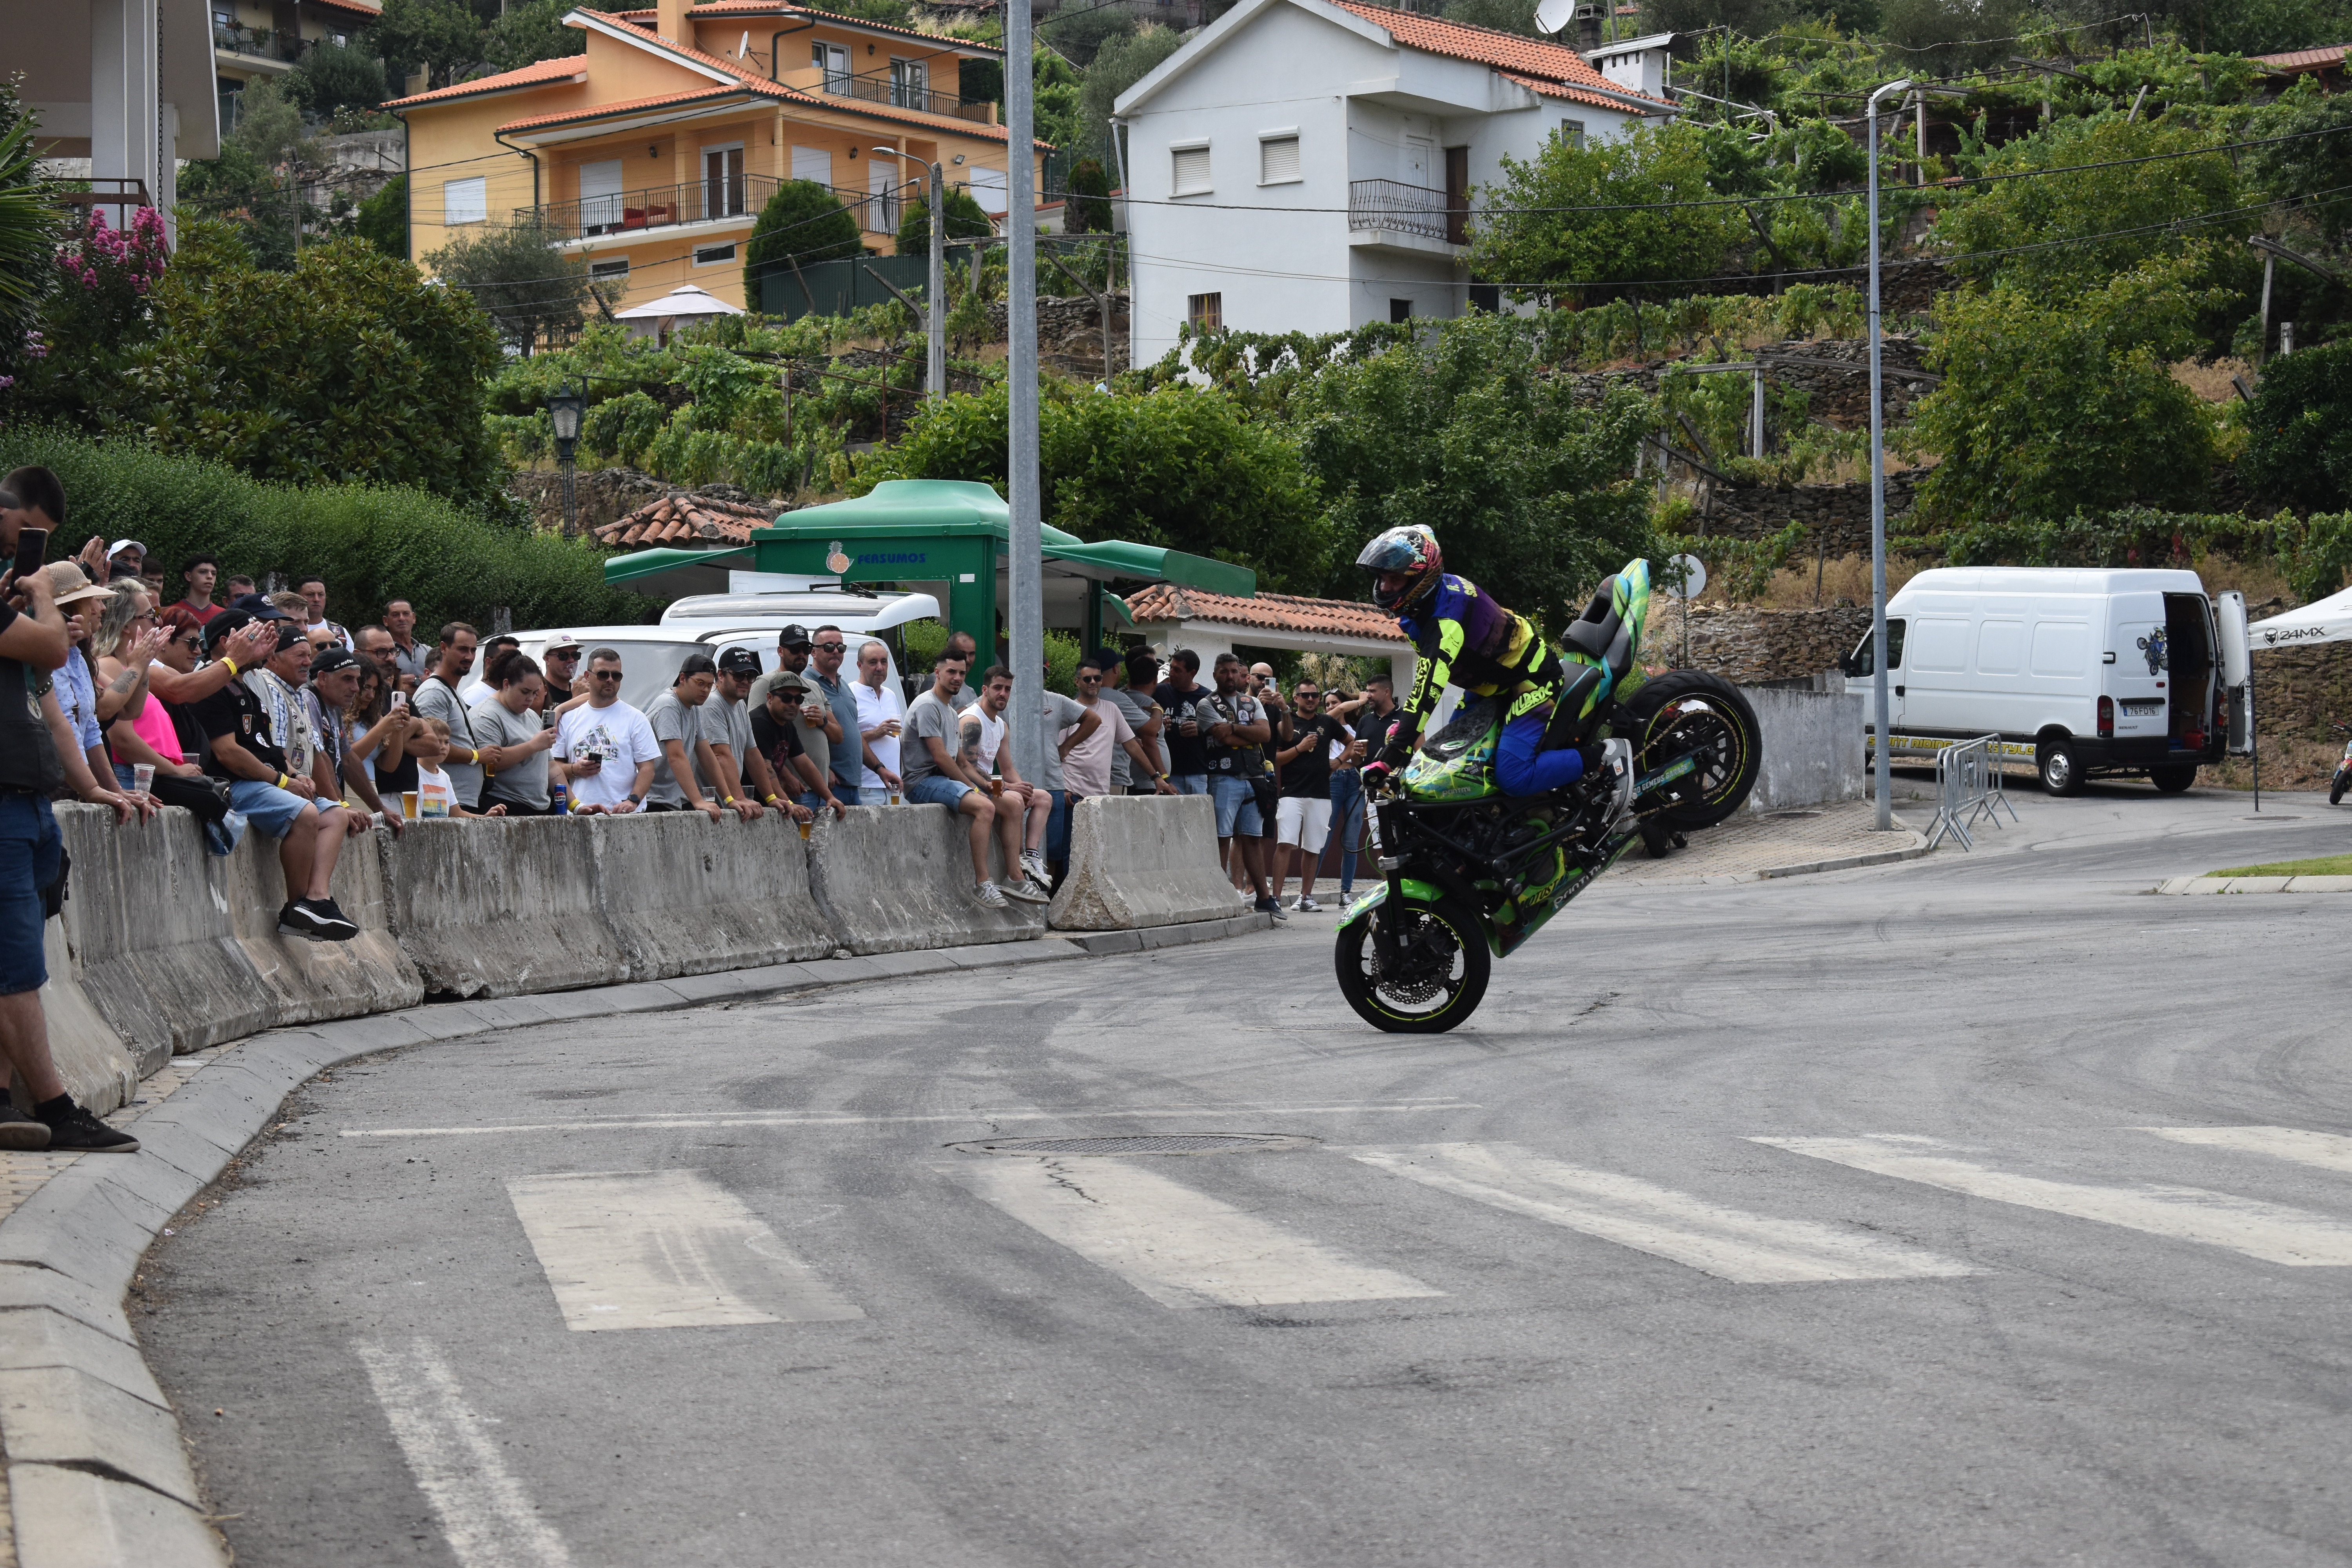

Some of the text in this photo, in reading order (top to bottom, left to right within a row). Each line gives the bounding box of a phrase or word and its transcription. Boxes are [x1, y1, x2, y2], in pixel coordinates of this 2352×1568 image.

[858, 553, 926, 564] FERSUMOS
[2279, 626, 2325, 640] 24MX
[1867, 736, 1909, 748] SNT
[1665, 763, 1688, 779] GARAGE
